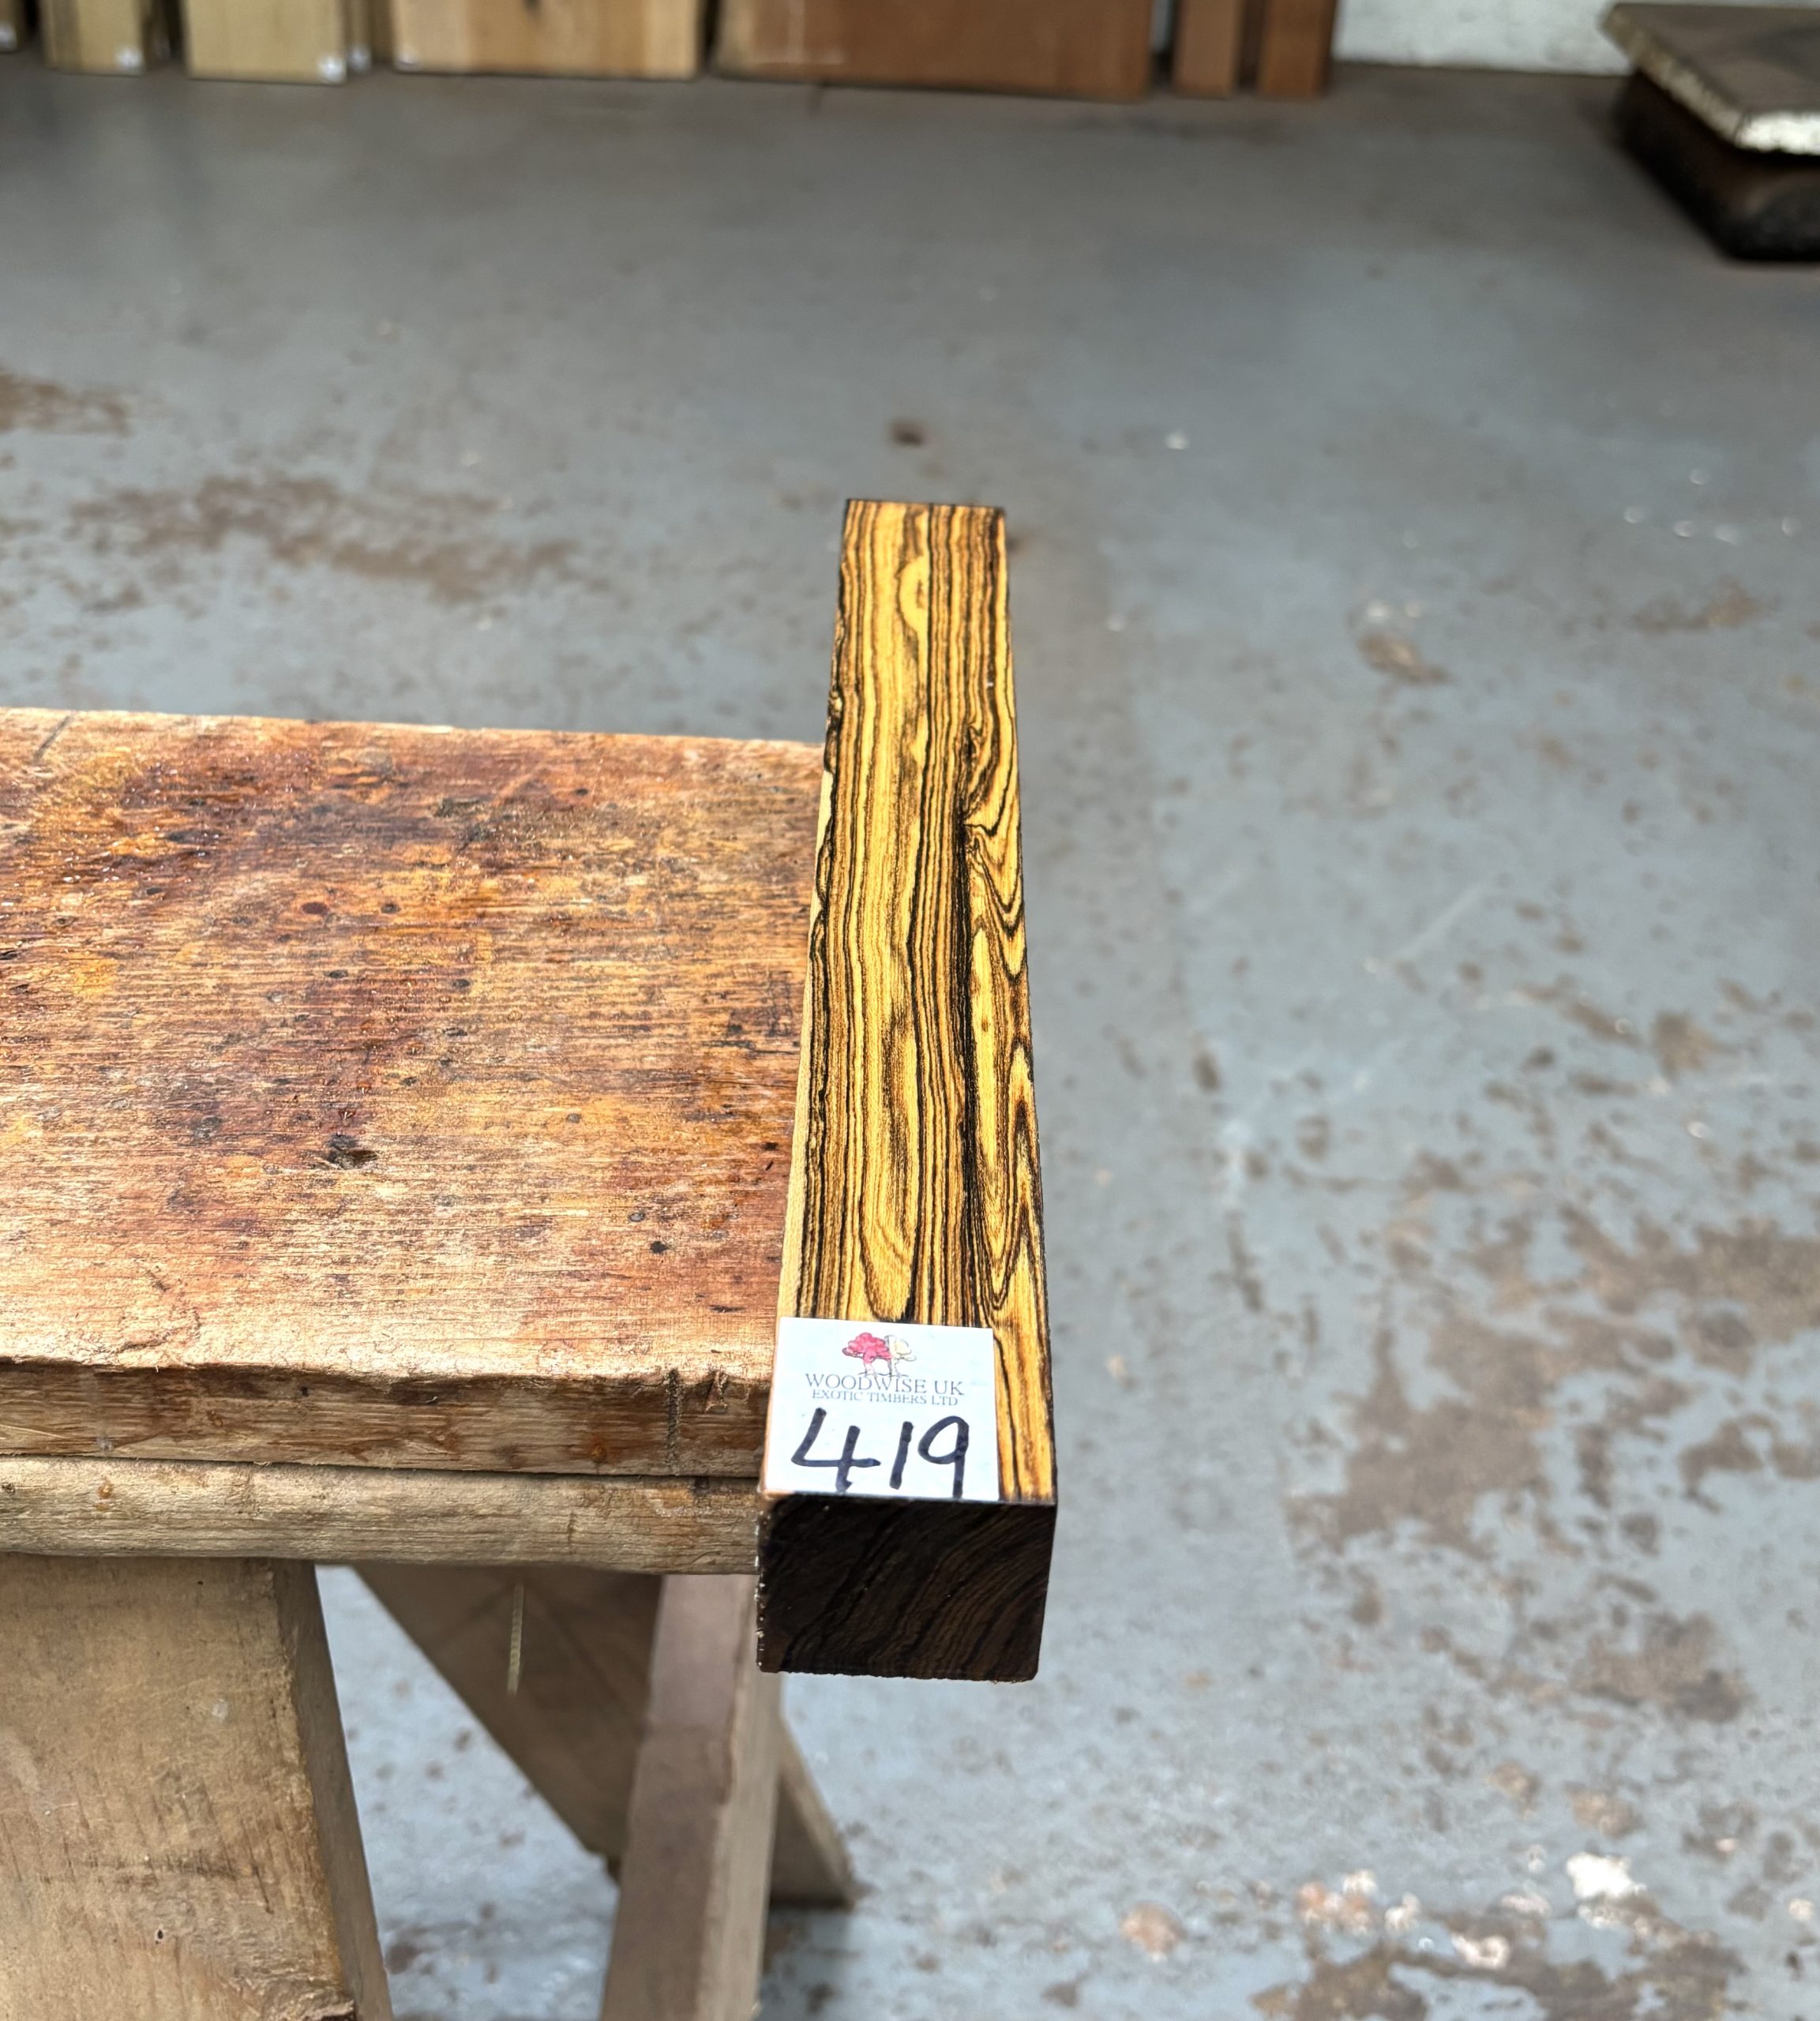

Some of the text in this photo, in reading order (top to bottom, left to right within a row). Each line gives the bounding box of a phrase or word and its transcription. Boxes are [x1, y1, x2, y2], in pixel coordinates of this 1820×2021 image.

[805, 1373, 965, 1395] WOODWISE UK
[812, 1389, 958, 1406] EXOTIC TIMBERS LTD
[790, 1408, 970, 1499] 419
